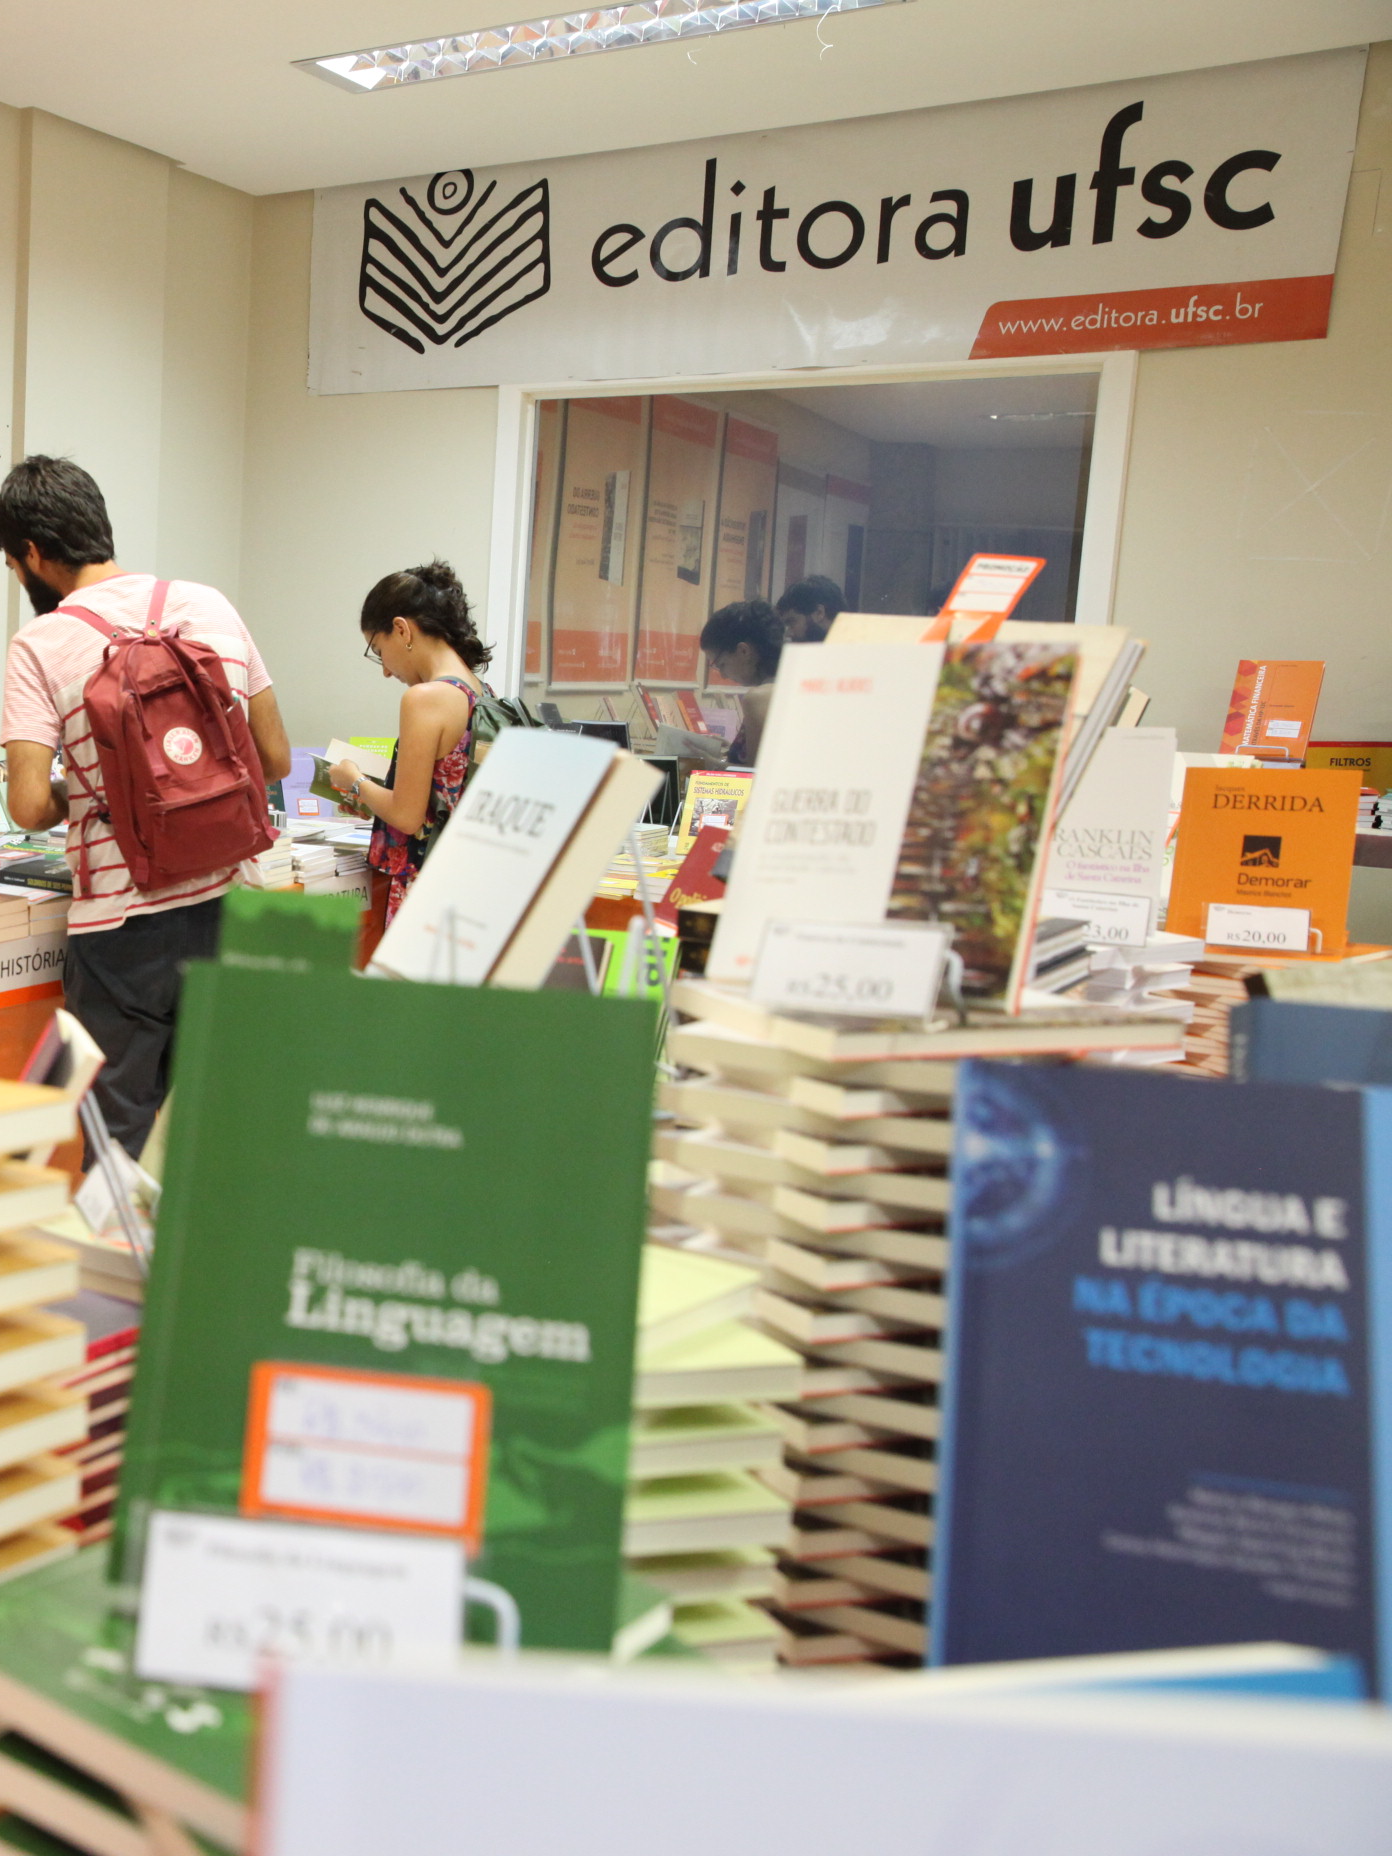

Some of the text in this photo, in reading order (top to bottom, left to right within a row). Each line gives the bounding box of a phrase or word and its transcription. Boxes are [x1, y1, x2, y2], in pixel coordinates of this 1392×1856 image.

[591, 101, 1282, 288] editora ufsc
[998, 292, 1264, 335] www.editora.ufsc.br
[1251, 665, 1267, 704] FINANCEIRA
[1329, 757, 1372, 767] FILTROS
[465, 789, 556, 838] IRAQUE
[1212, 793, 1325, 812] DERRIDA
[1237, 873, 1312, 889] Demorar
[0, 948, 65, 979] HISTÓRIA
[1151, 1175, 1348, 1240] LÍNGUA E
[291, 1247, 500, 1306] Filosofia da
[1098, 1225, 1350, 1292] LITERATURA
[285, 1279, 592, 1364] Linguagem
[1073, 1273, 1349, 1343] NA ÉPOCA DA
[1083, 1326, 1352, 1397] TECNOLOGIA
